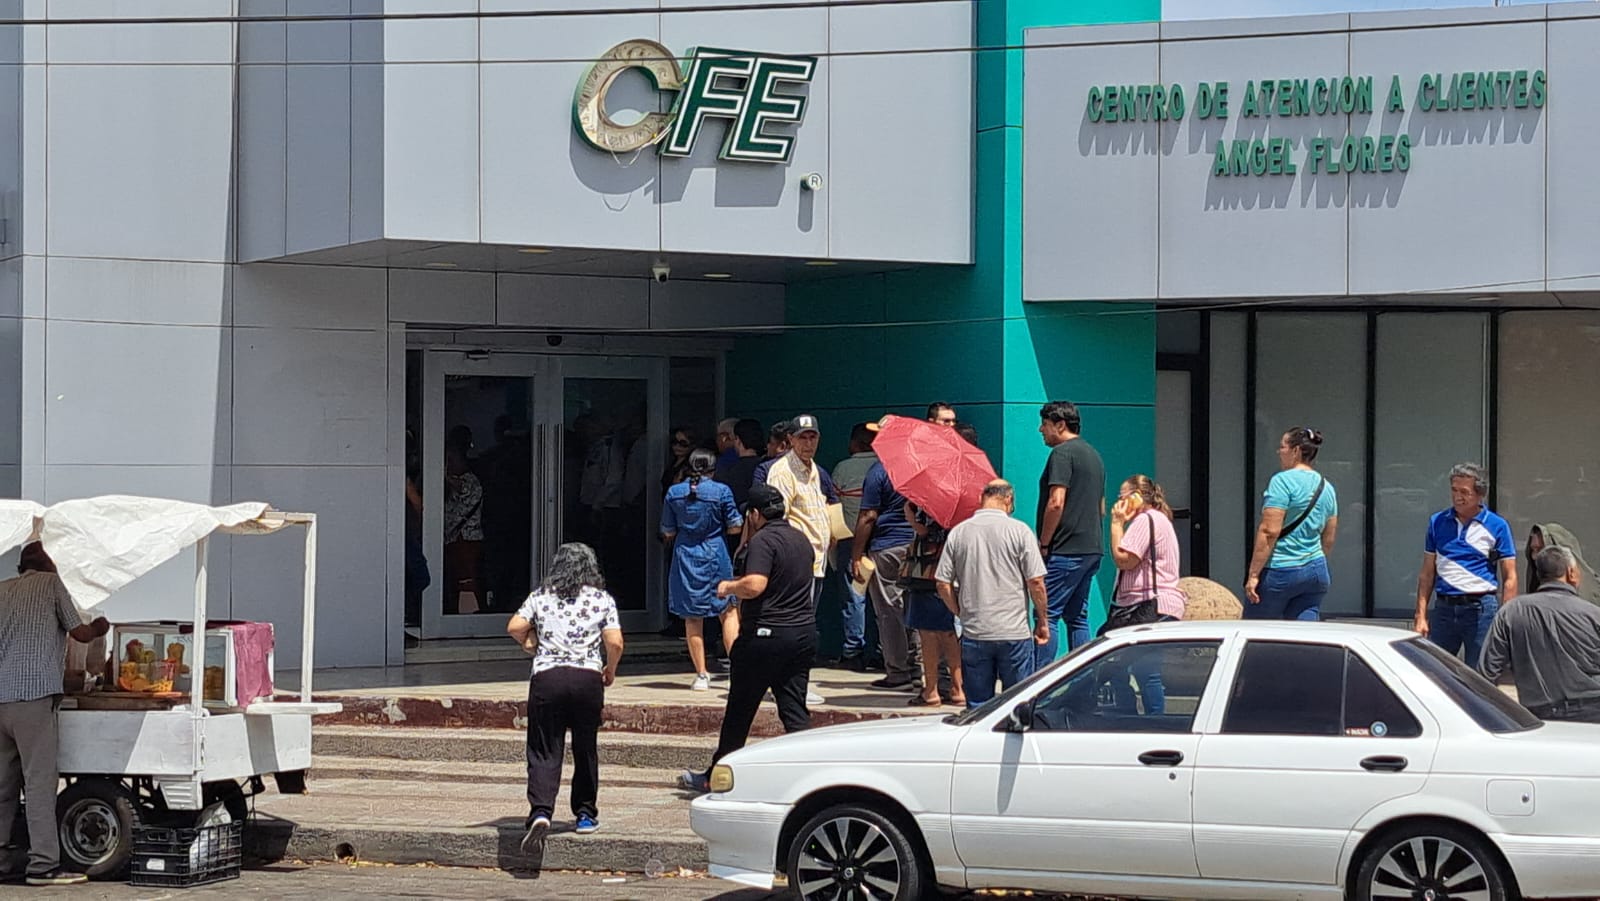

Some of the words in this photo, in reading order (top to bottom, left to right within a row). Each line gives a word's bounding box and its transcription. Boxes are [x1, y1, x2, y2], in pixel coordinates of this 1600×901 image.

[571, 38, 818, 163] CFE
[1087, 83, 1185, 122] CENTRO
[1198, 81, 1228, 119] DE
[1243, 76, 1372, 118] ATENCION
[1388, 74, 1405, 113] A
[1418, 69, 1546, 111] CLIENTES
[1214, 137, 1297, 176] ANGEL
[1310, 133, 1412, 173] FLORES
